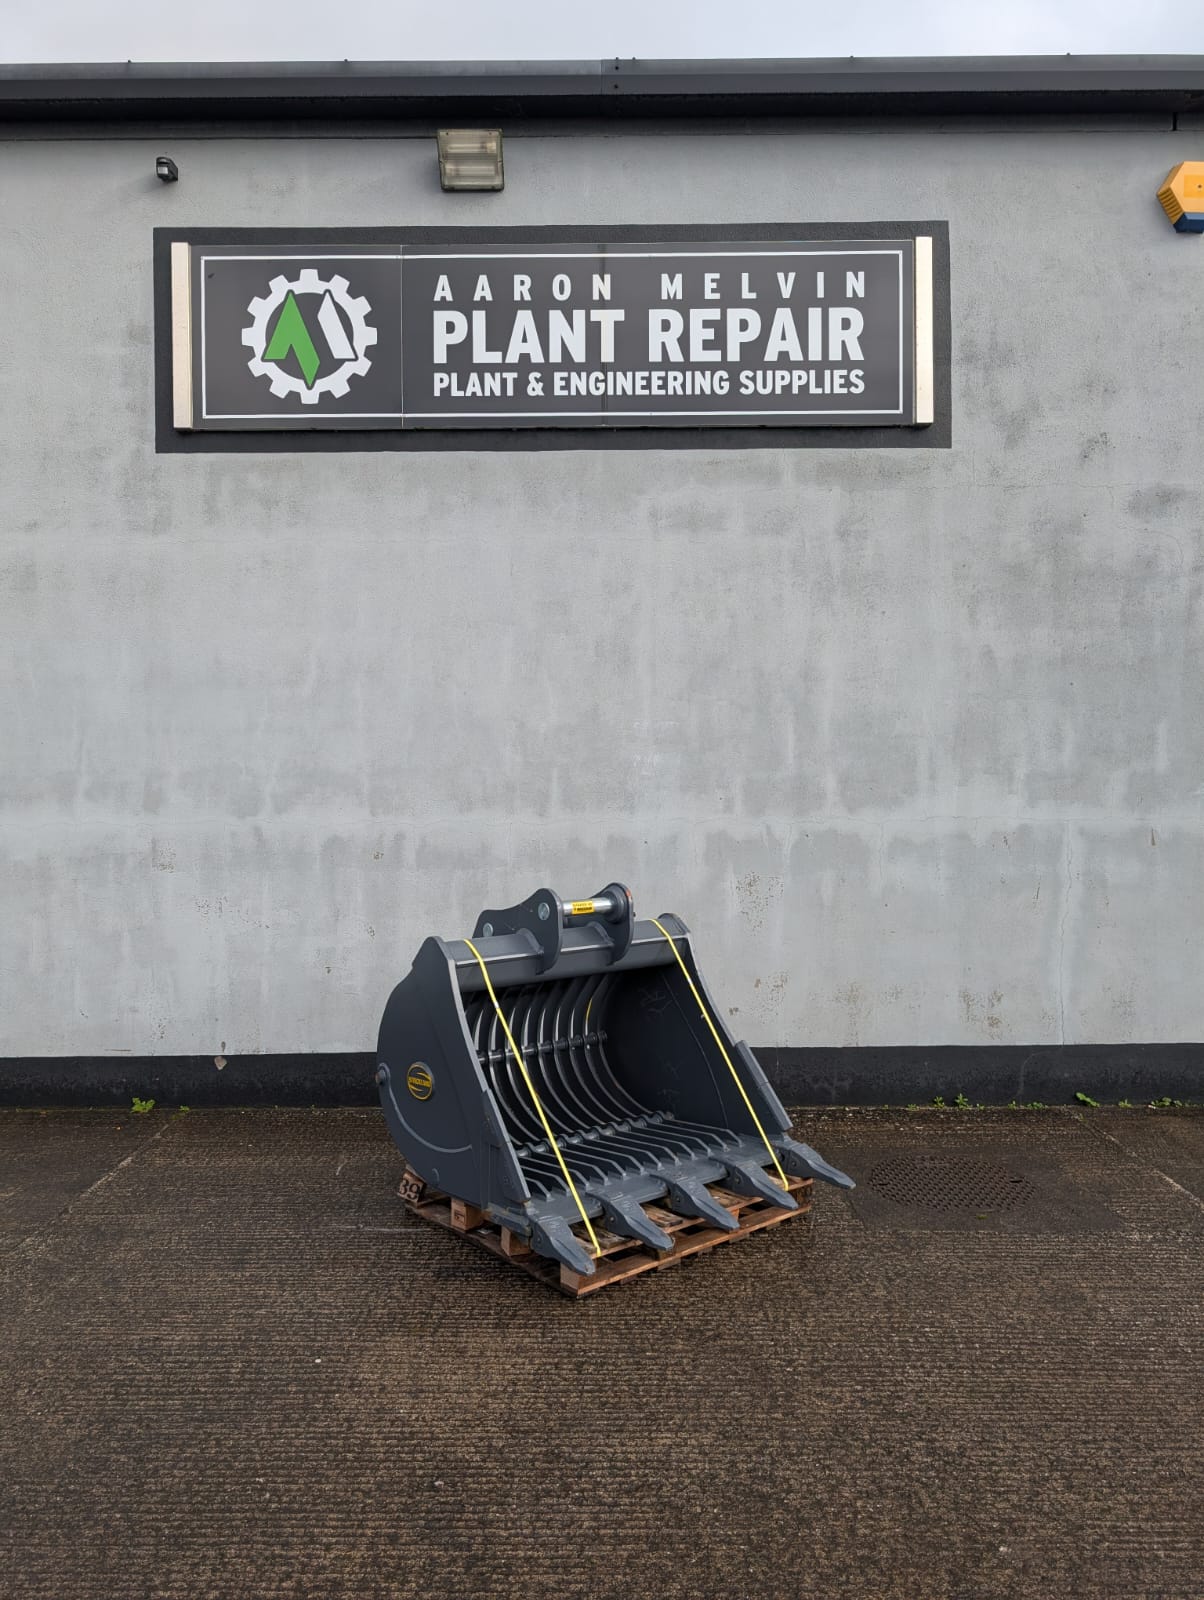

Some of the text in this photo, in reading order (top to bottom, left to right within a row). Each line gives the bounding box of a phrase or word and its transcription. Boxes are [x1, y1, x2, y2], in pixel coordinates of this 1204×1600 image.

[433, 271, 865, 301] AARON MELVIN
[433, 306, 865, 364] PLANT REPAIR
[433, 368, 865, 397] PLANT & ENGINEERING SUPPLIES
[399, 1179, 420, 1200] 39
